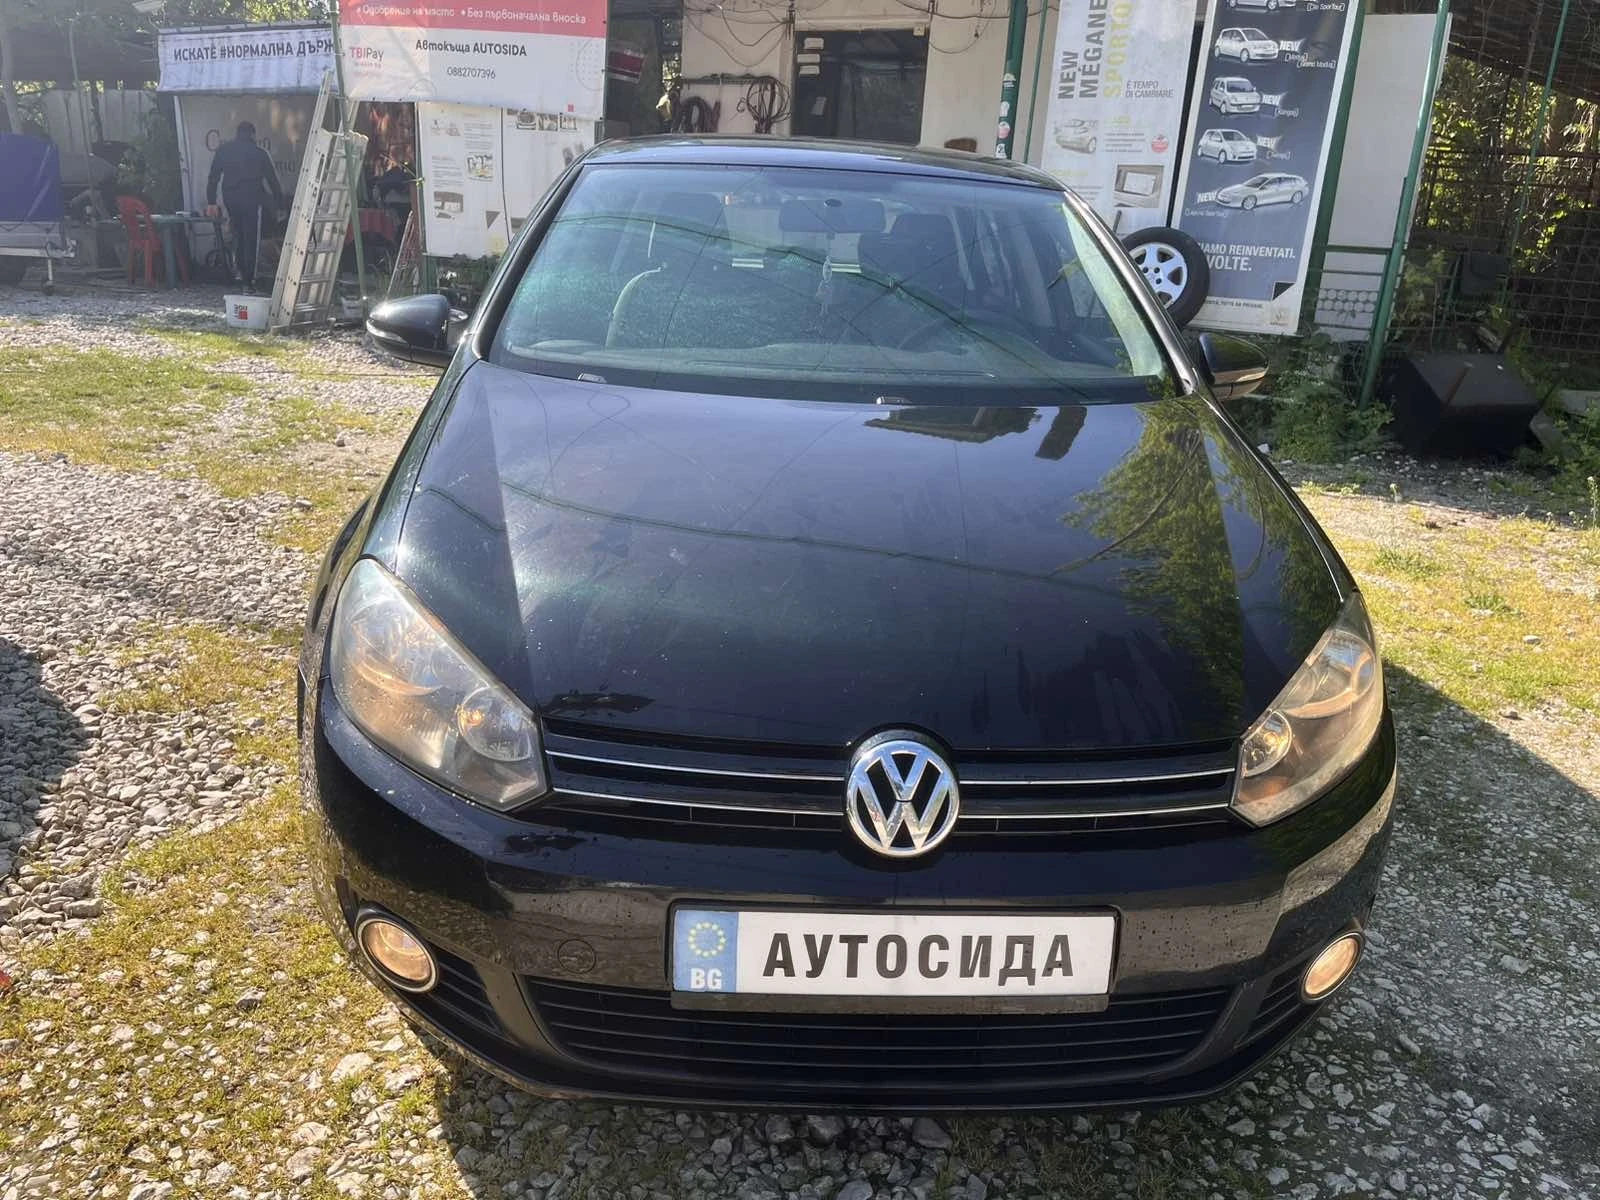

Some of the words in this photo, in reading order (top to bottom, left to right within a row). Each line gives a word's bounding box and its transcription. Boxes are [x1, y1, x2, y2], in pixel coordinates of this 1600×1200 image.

[362, 4, 411, 17] Одобрение
[467, 7, 483, 18] Без
[485, 9, 550, 22] първоначална
[552, 11, 586, 24] вноска
[174, 45, 217, 61] ИСКАТЕ
[220, 44, 293, 60] #НОРМАЛНА
[415, 39, 470, 54] Автокъща
[473, 42, 527, 57] AUTOSIDA
[1280, 39, 1301, 51] NEW
[446, 66, 496, 80] 0882707396
[1058, 51, 1078, 99] NEW
[1133, 80, 1159, 89] TEMPO
[1134, 88, 1174, 98] CAMBIARE
[1229, 244, 1296, 259] REINVENTATI.
[1206, 254, 1252, 271] VOLTE.
[762, 932, 1074, 987] АУТОСИДА
[690, 968, 722, 989] BG
